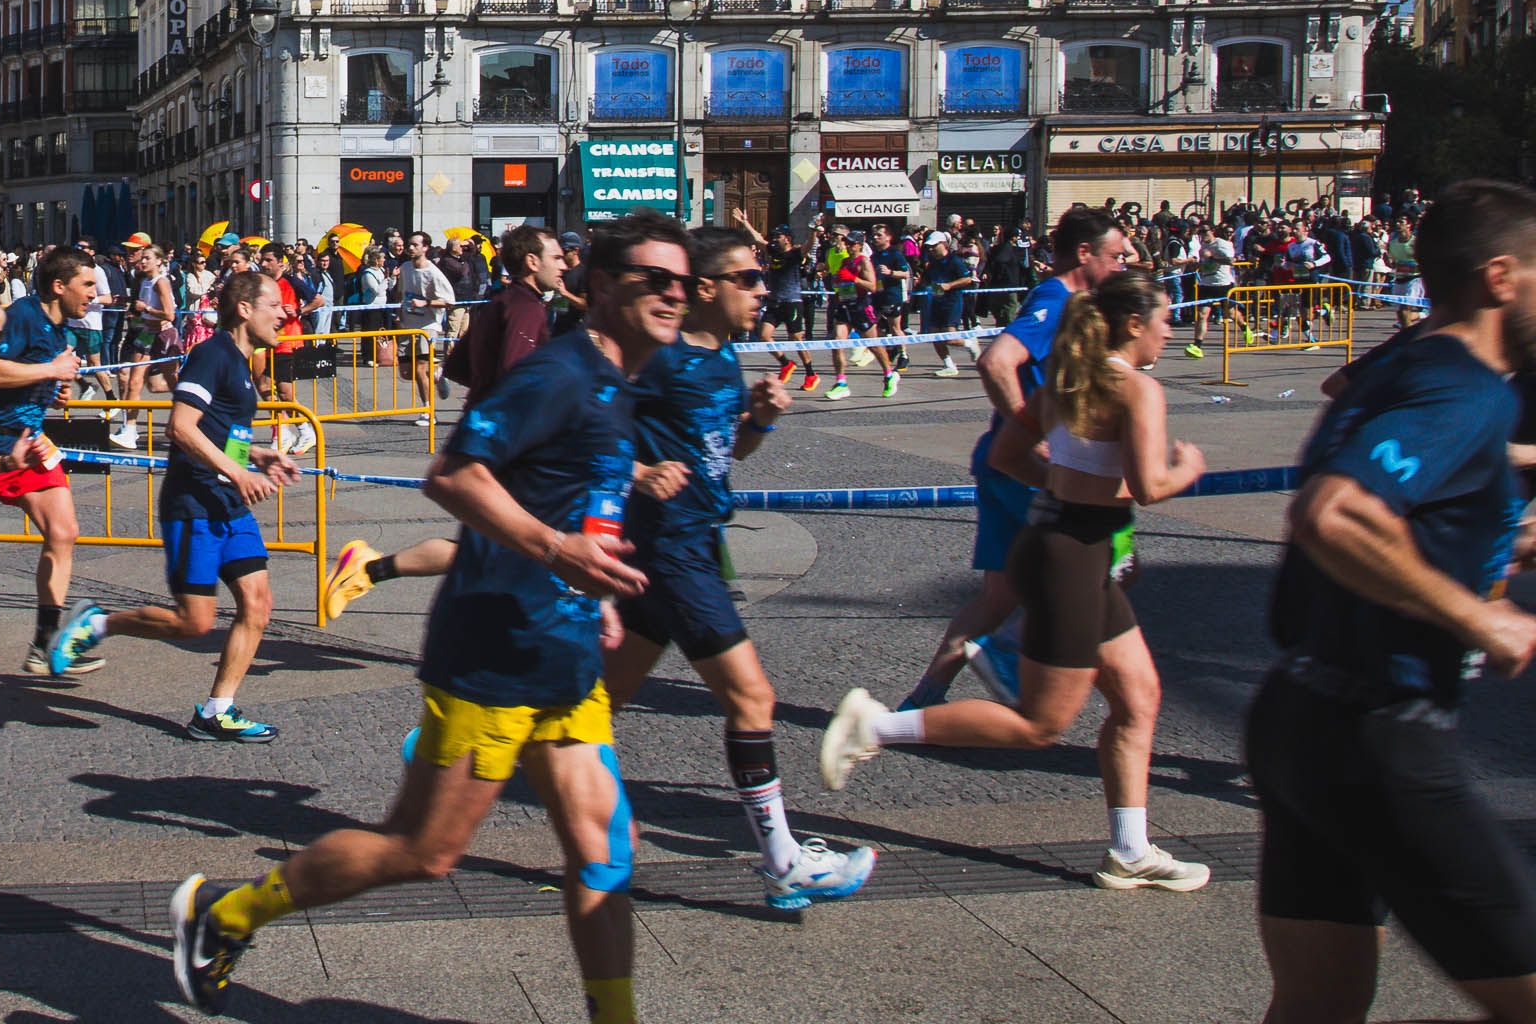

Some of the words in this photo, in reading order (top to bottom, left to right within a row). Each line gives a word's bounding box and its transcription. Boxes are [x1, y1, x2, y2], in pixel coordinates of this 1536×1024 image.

[589, 143, 674, 156] CHANGE
[1098, 135, 1165, 152] CASA
[1177, 135, 1211, 152] DE
[826, 157, 900, 170] CHANGE
[940, 154, 1022, 170] GELATO
[350, 167, 405, 183] Orange
[592, 167, 676, 178] TRANSFER
[593, 188, 677, 200] CAMBIO
[854, 204, 911, 214] CHANGE
